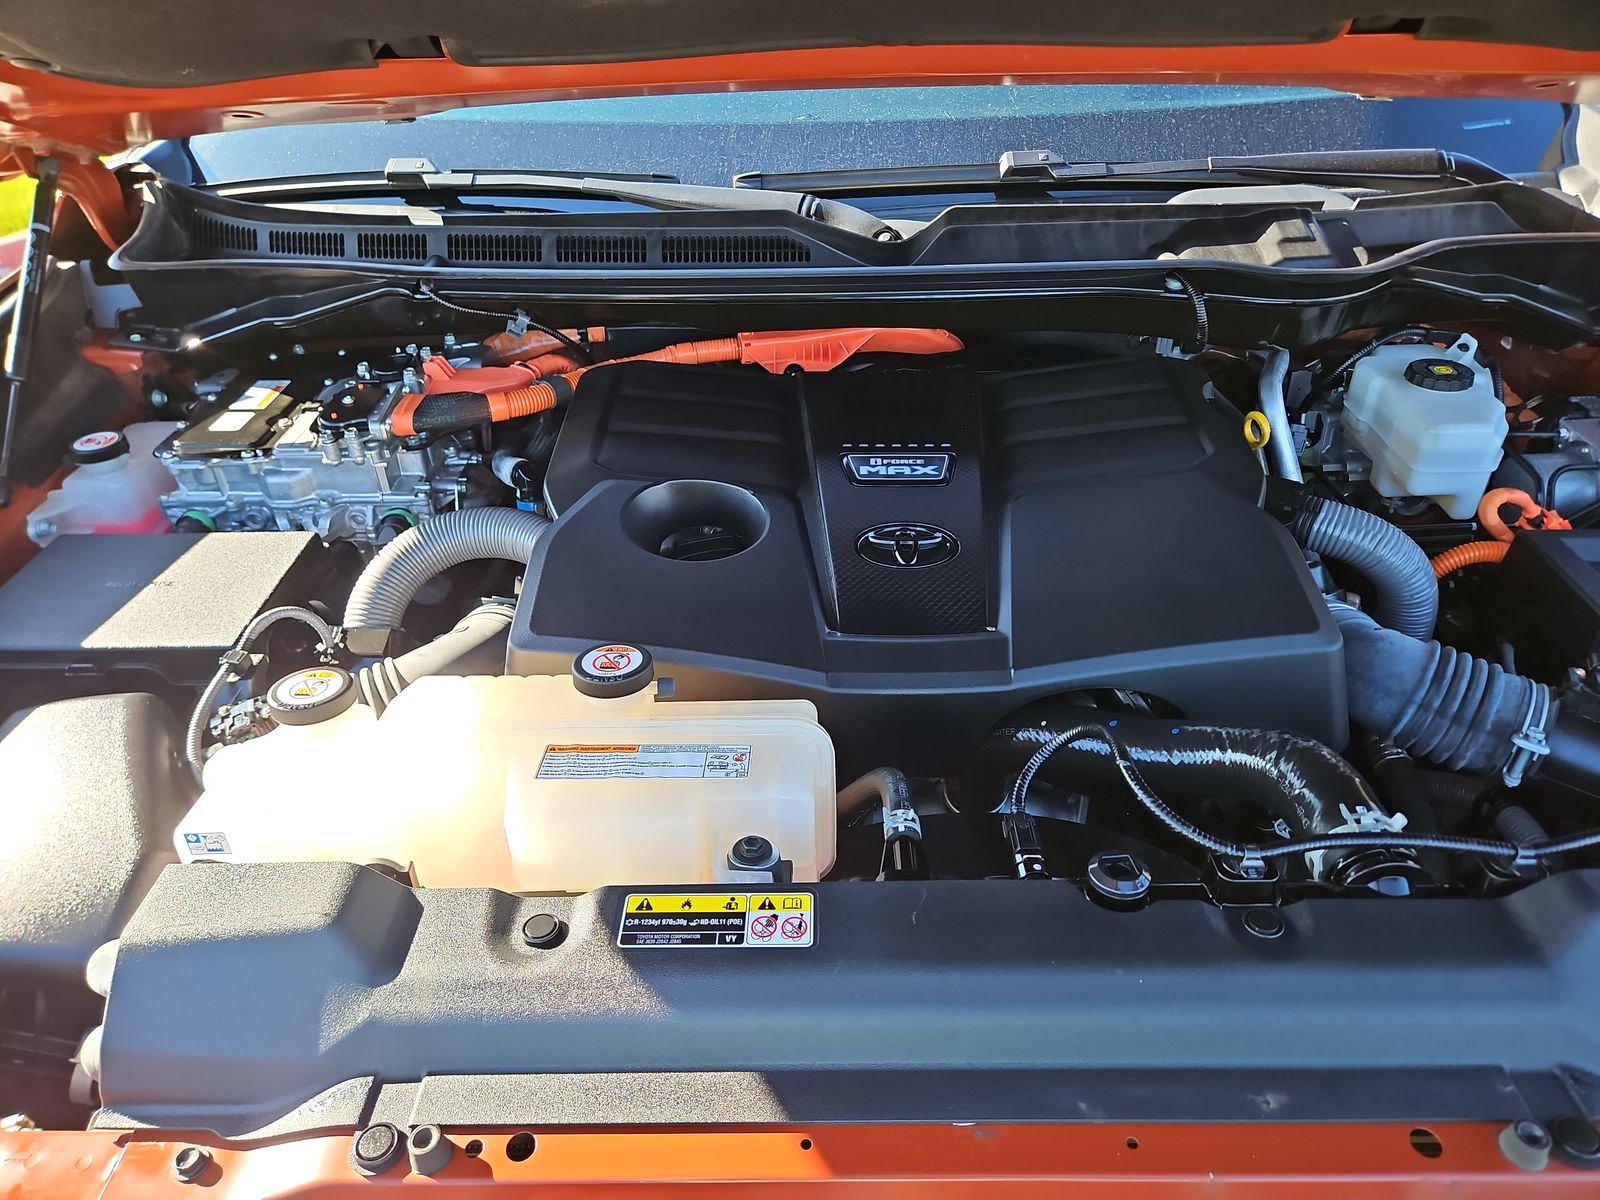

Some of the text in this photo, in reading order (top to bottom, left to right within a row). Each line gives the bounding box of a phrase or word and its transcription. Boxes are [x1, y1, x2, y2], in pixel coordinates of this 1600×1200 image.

[859, 465, 940, 475] MAX
[633, 918, 661, 926] R-1234yf
[727, 918, 743, 926] (POE)
[725, 934, 737, 942] VY
